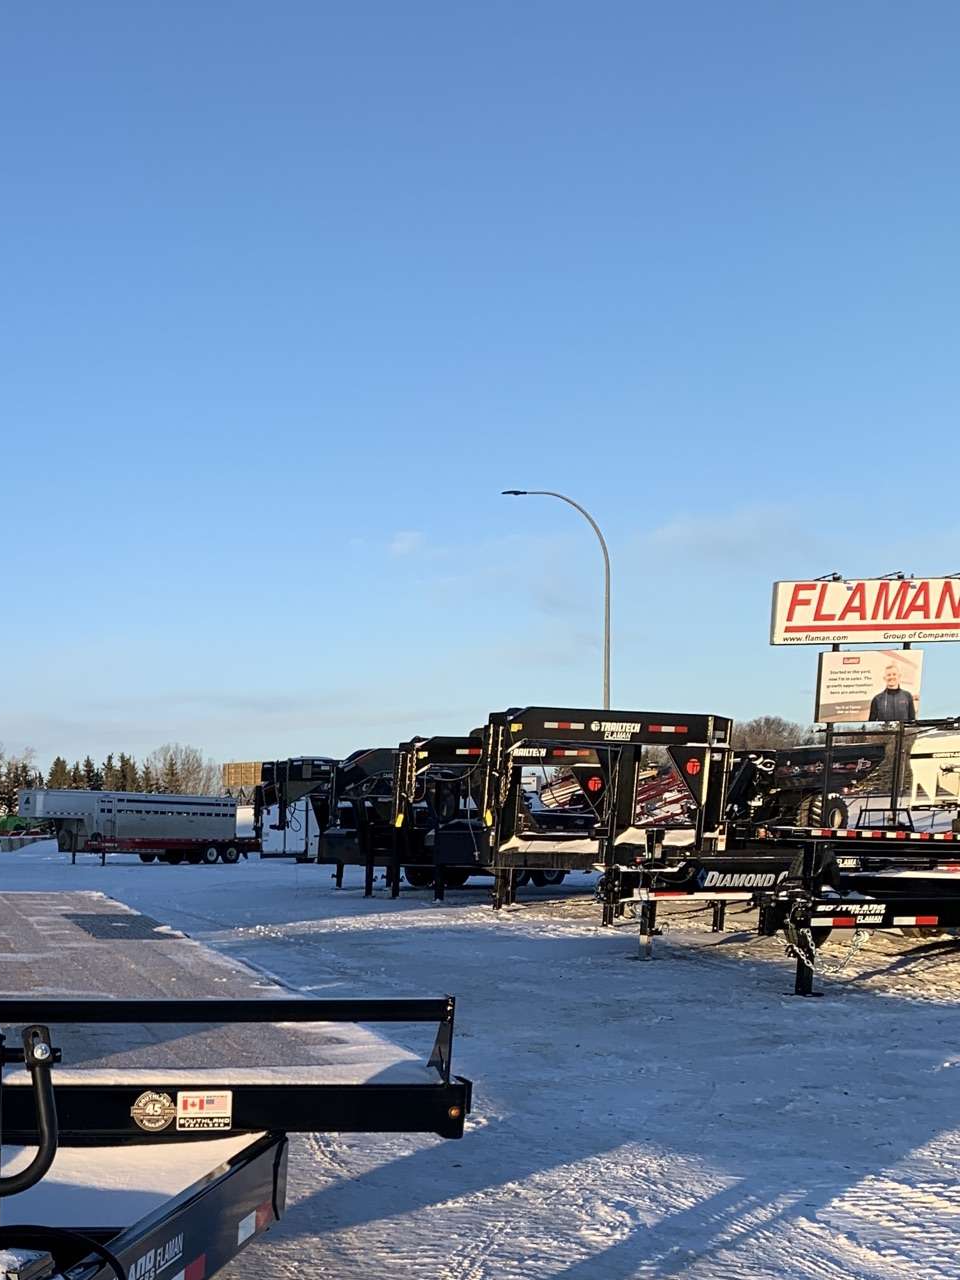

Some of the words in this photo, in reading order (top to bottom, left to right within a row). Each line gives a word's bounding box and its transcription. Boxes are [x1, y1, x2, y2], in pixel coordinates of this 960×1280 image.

[786, 580, 960, 622] FLAMAN
[783, 634, 848, 642] www.flaman.com
[883, 632, 907, 641] Group
[908, 631, 917, 639] of
[918, 630, 959, 640] Companies
[704, 870, 776, 887] DIAMOND
[145, 1103, 162, 1116] 45
[156, 1232, 184, 1269] FLAMAN
